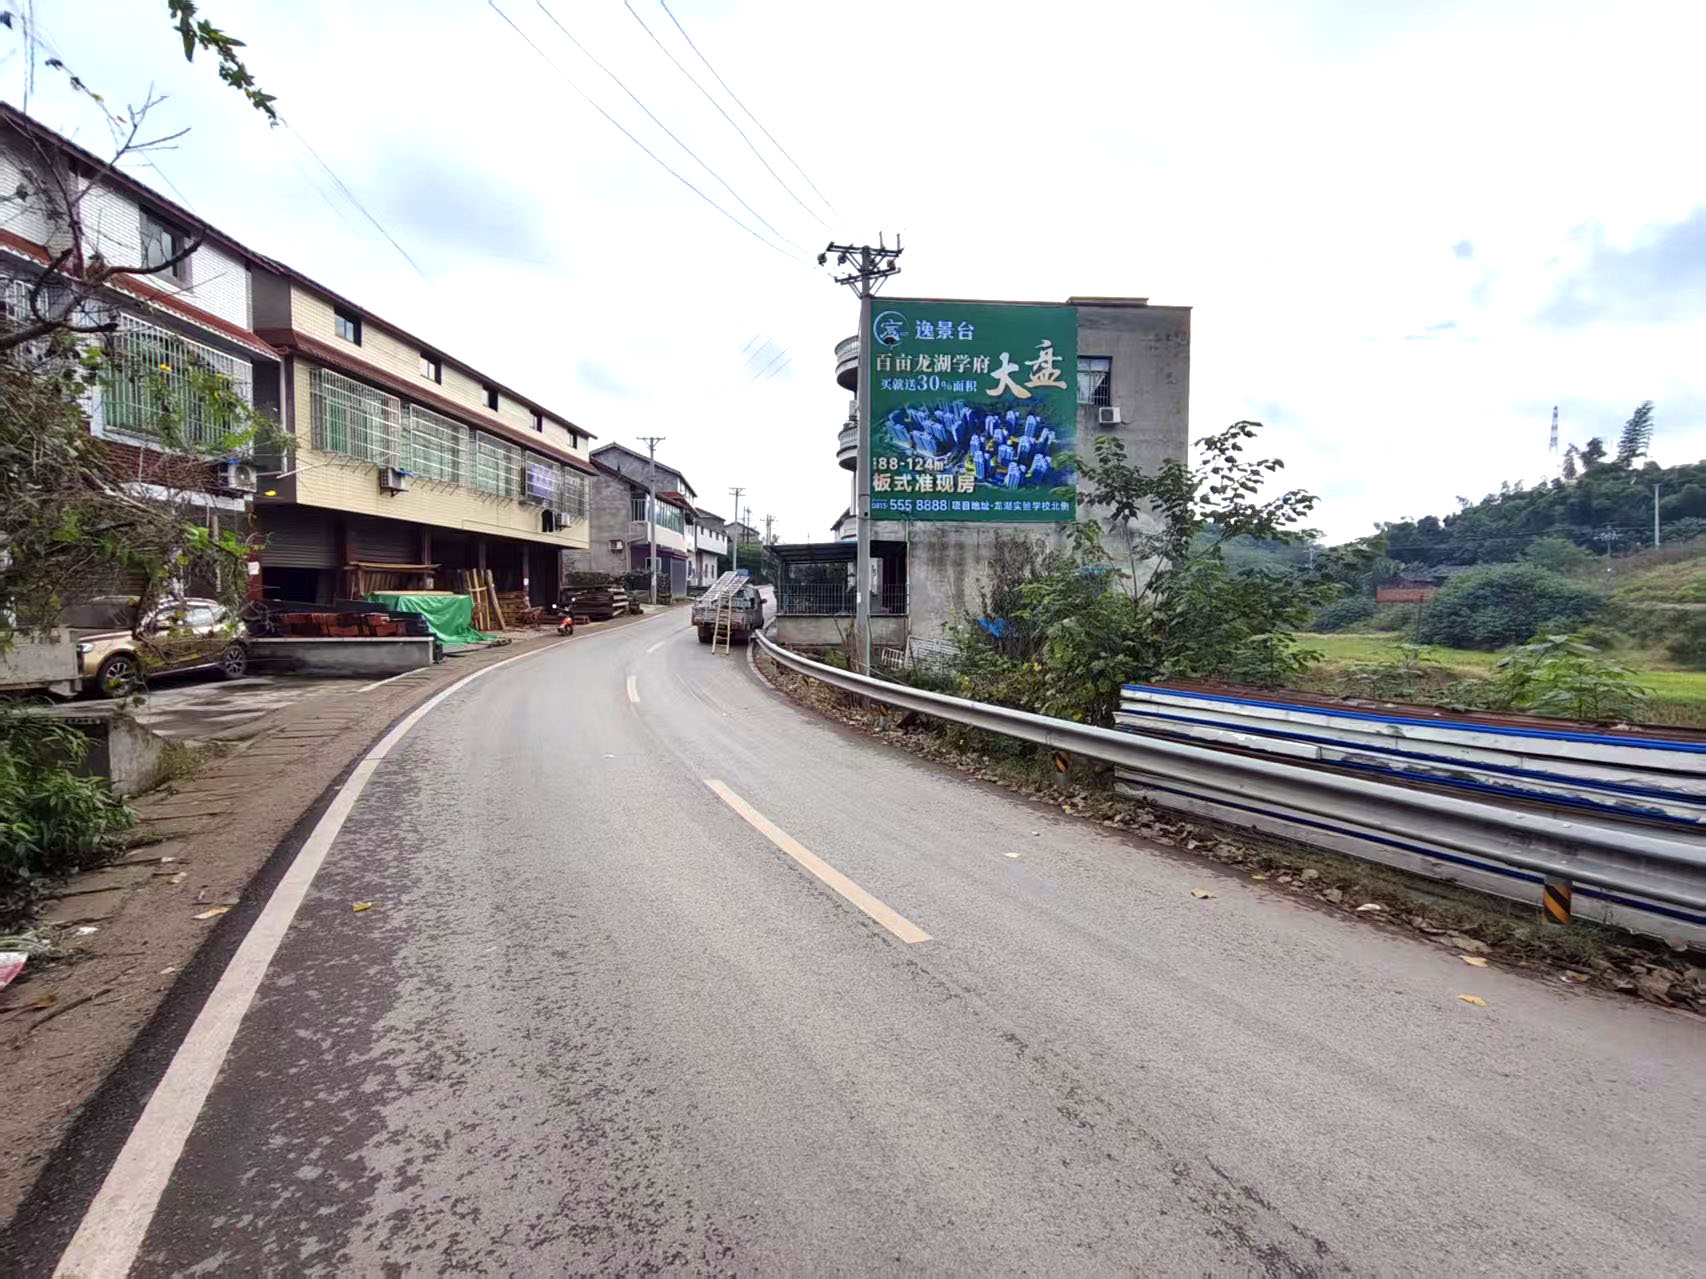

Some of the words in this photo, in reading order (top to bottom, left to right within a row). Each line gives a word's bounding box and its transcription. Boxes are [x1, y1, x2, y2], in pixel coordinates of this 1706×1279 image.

[915, 320, 974, 340] 逸景台
[876, 353, 990, 374] 百亩龙湖学府
[985, 339, 1067, 399] 大盘
[872, 472, 976, 493] 板式准现房
[915, 499, 947, 511] 8888
